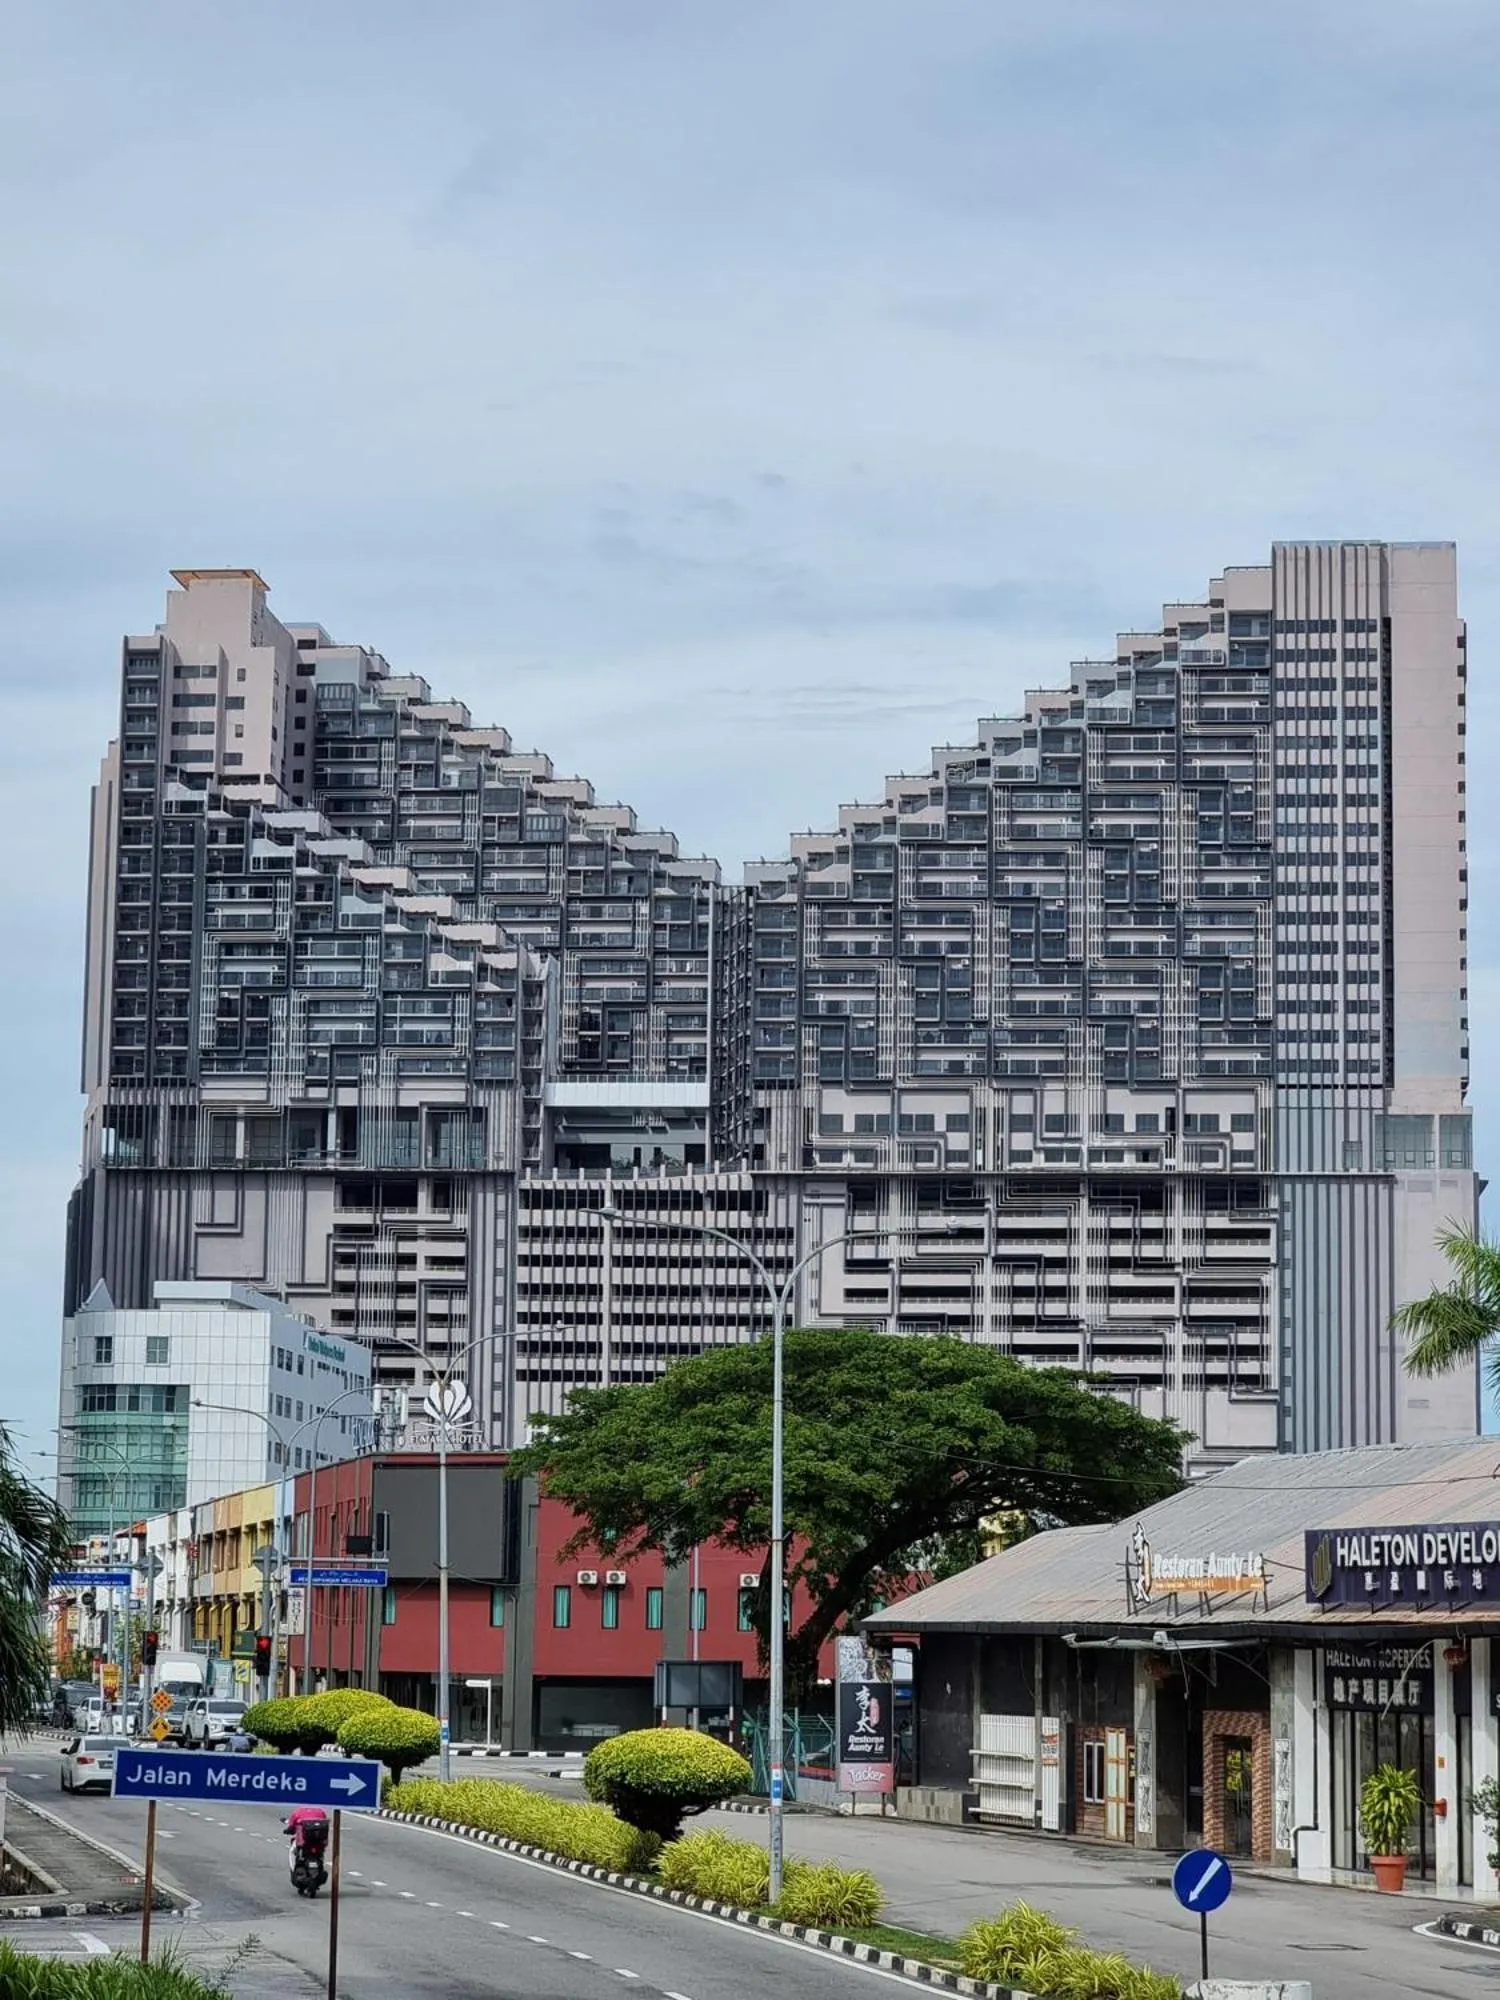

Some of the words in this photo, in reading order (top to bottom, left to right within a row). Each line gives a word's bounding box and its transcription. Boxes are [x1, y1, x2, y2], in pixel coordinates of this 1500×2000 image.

[1336, 1535, 1418, 1567] HALETON
[1423, 1530, 1500, 1565] DEVELO
[1154, 1553, 1204, 1578] Restoran
[1208, 1552, 1243, 1582] Aunty
[848, 1735, 885, 1744] Restoran
[126, 1765, 191, 1786] Jalan
[206, 1768, 307, 1791] Merdeka
